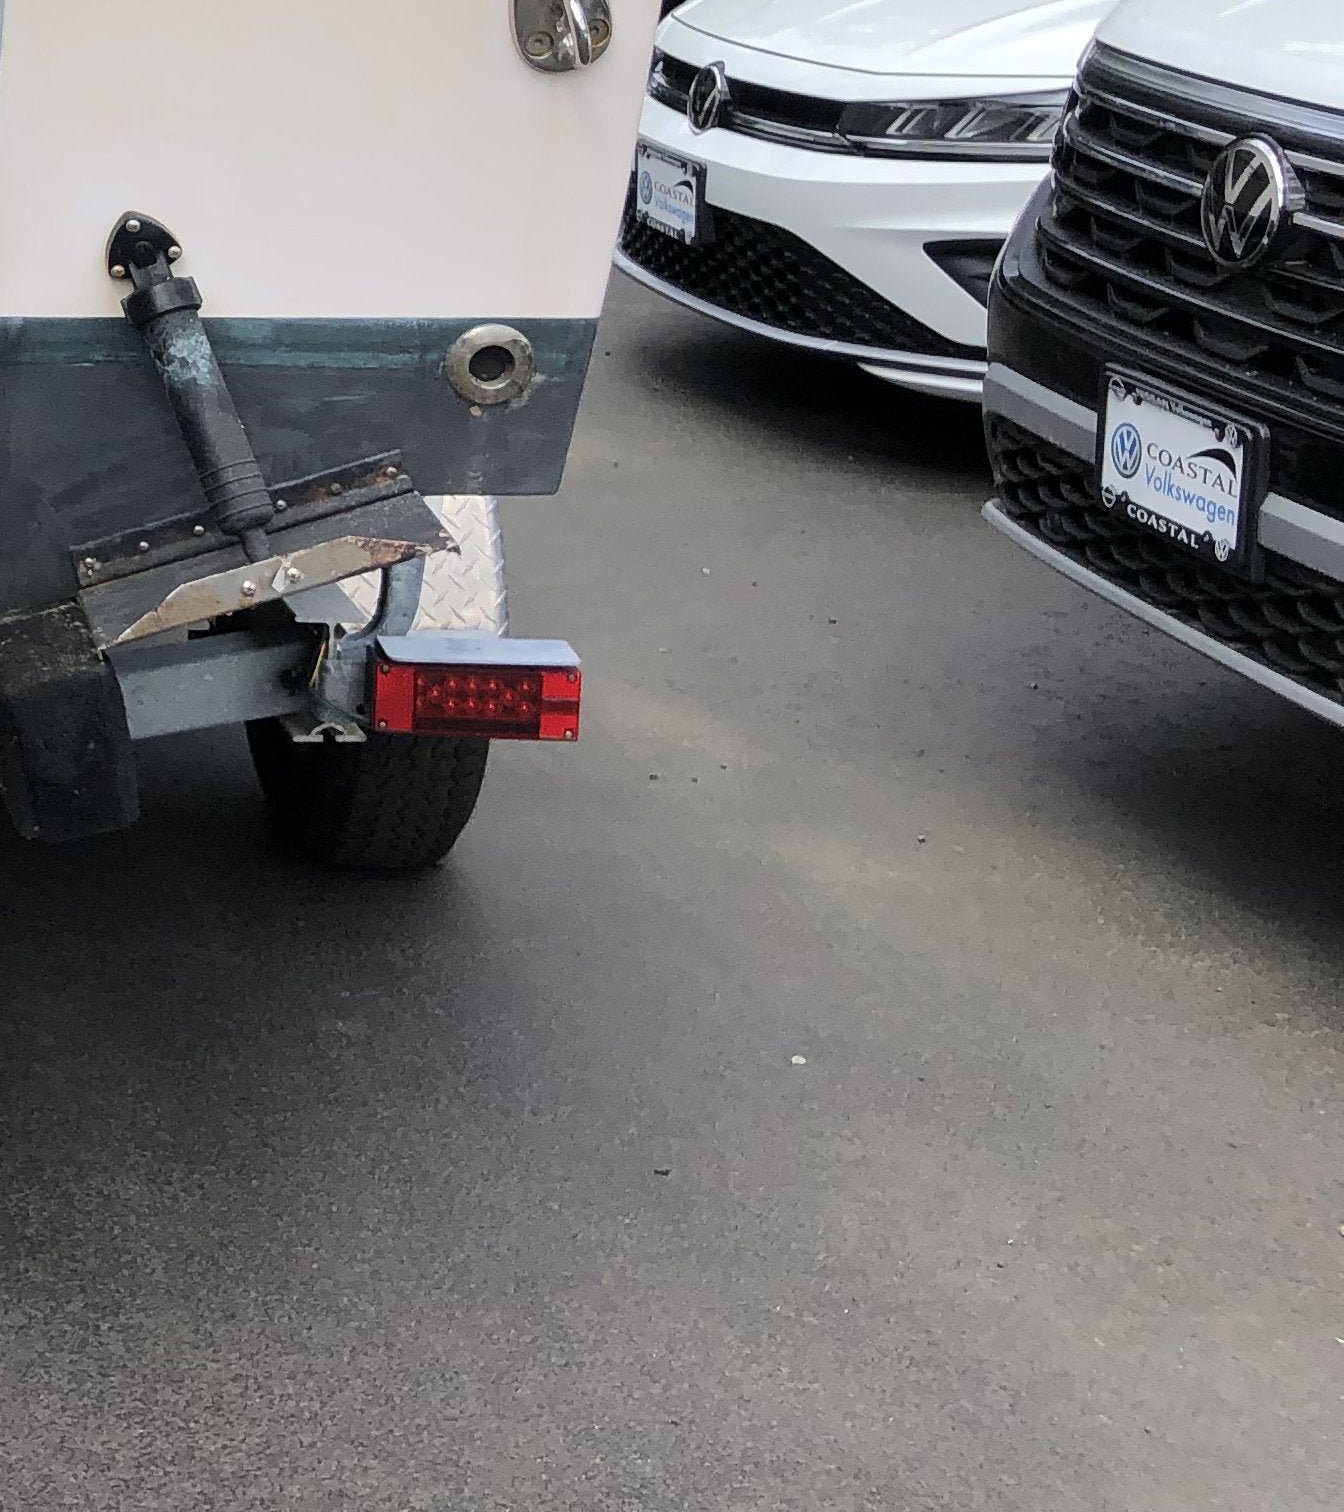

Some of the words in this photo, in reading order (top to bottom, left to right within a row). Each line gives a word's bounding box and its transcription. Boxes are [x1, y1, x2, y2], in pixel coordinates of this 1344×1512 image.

[654, 181, 694, 208] COASTAL
[1145, 462, 1236, 526] Volkswagen
[1146, 441, 1238, 498] COASTAL
[1126, 503, 1200, 550] COASTAL
